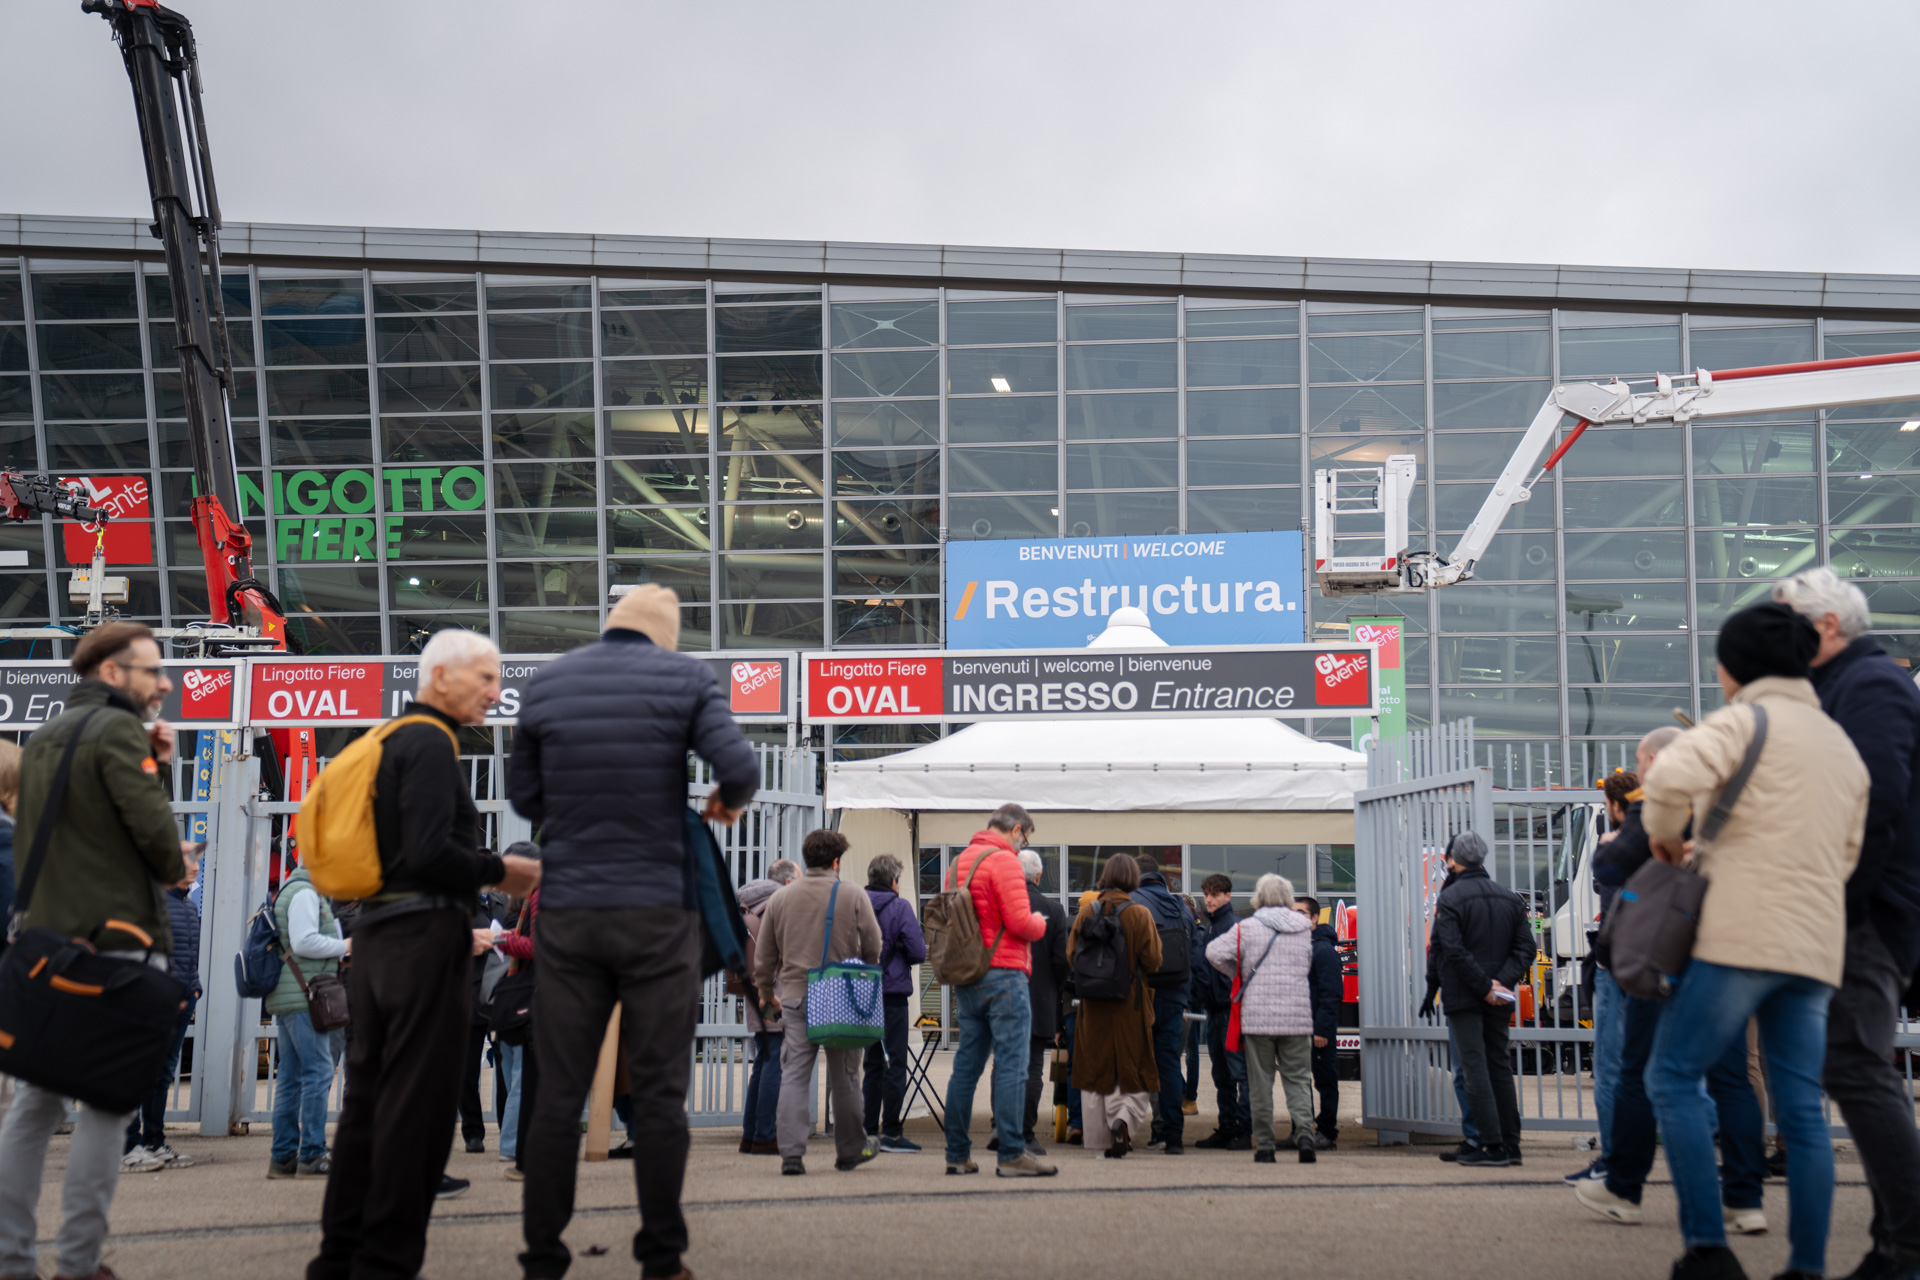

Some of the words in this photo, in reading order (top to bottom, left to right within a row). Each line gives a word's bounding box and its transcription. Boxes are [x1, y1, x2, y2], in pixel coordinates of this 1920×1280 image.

[191, 466, 485, 516] NGOTTO
[80, 480, 149, 533] ents
[276, 517, 404, 561] FIERE
[1019, 544, 1118, 561] BENVENUTI
[1133, 541, 1226, 558] WELCOME
[986, 575, 1297, 619] Restructura.
[1355, 624, 1381, 643] GL
[262, 665, 324, 684] Lingotto
[328, 665, 366, 681] Fiere
[498, 664, 538, 678] lcom
[731, 661, 761, 683] GL
[820, 662, 883, 680] Lingotto
[887, 661, 927, 676] Fiere
[953, 659, 1030, 675] benvenuti
[1043, 658, 1115, 673] welcome
[1128, 657, 1212, 672] bienvenue
[1315, 653, 1346, 675] GL
[1324, 655, 1368, 688] events
[183, 669, 212, 690] GL
[191, 671, 232, 702] events
[740, 664, 782, 695] events
[268, 689, 359, 718] OVAL
[826, 685, 921, 714] OVAL
[952, 681, 1139, 712] INGRESSO
[1150, 681, 1295, 710] Entrance
